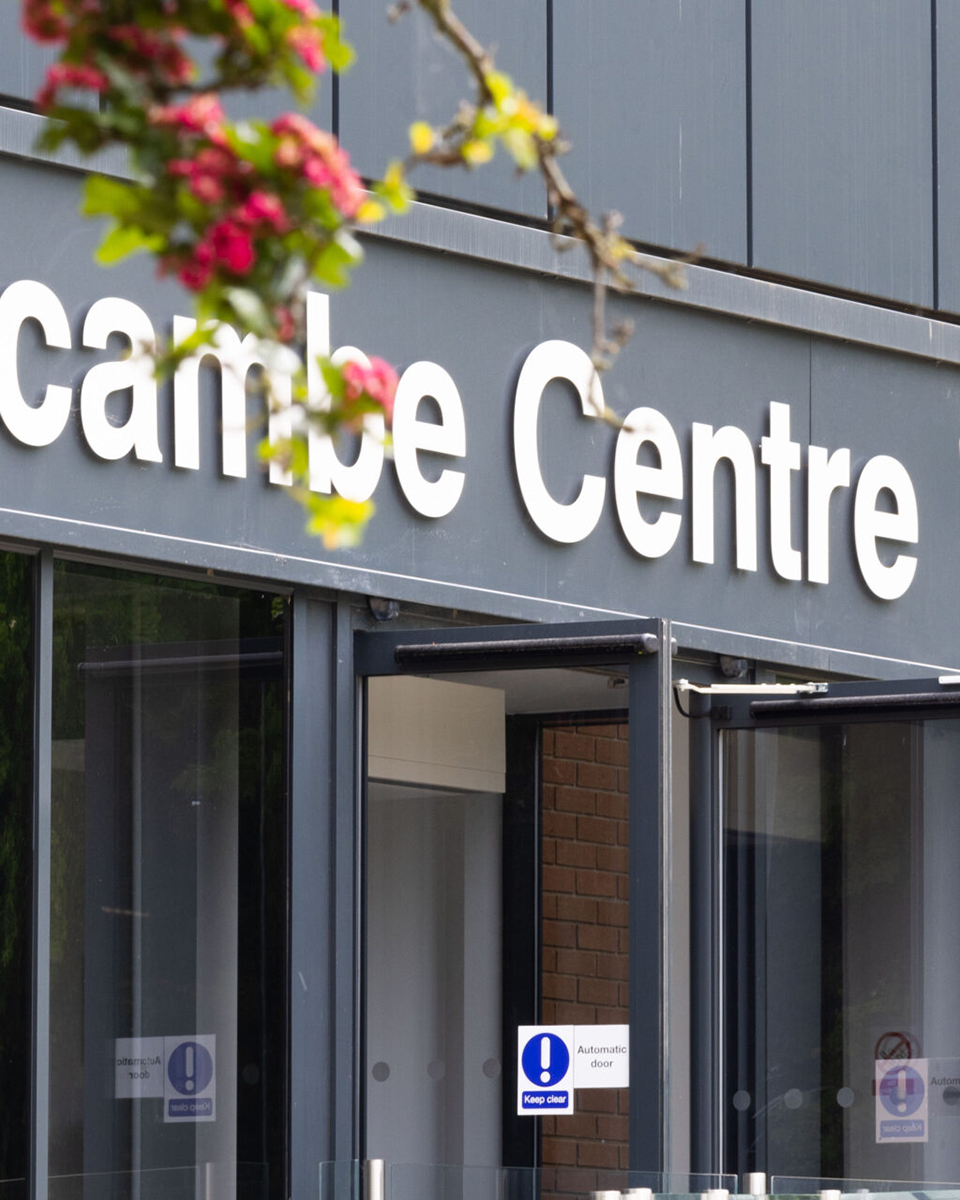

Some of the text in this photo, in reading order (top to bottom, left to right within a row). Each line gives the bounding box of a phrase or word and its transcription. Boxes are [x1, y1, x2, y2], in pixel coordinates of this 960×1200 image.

[513, 339, 919, 601] Centre
[577, 1045, 627, 1054] Automatic
[590, 1059, 613, 1068] door
[524, 1095, 567, 1105] Keep clear
